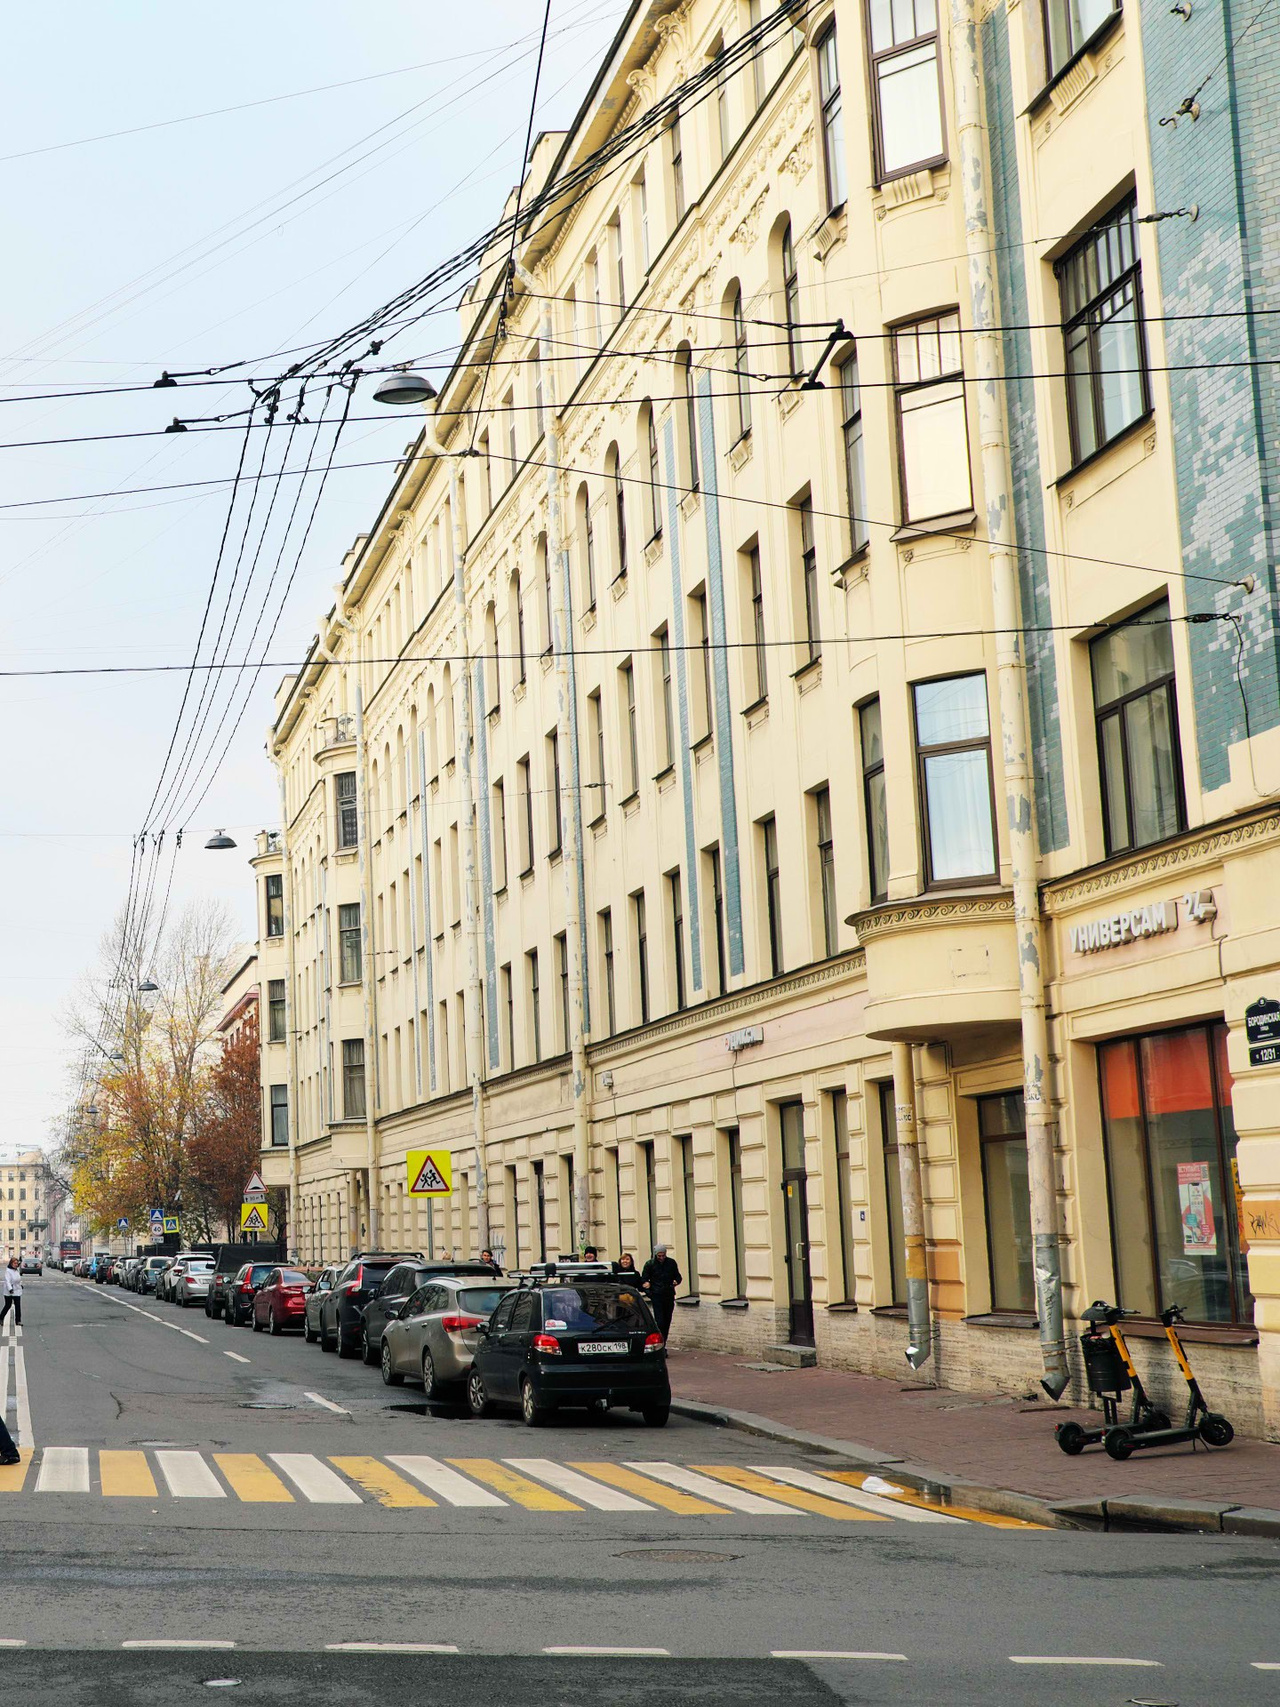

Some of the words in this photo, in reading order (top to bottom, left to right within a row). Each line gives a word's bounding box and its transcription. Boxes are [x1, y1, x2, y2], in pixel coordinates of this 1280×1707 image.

[1069, 901, 1166, 953] УНИВЕРСАМ
[1182, 888, 1217, 922] 24
[613, 1342, 627, 1350] 198
